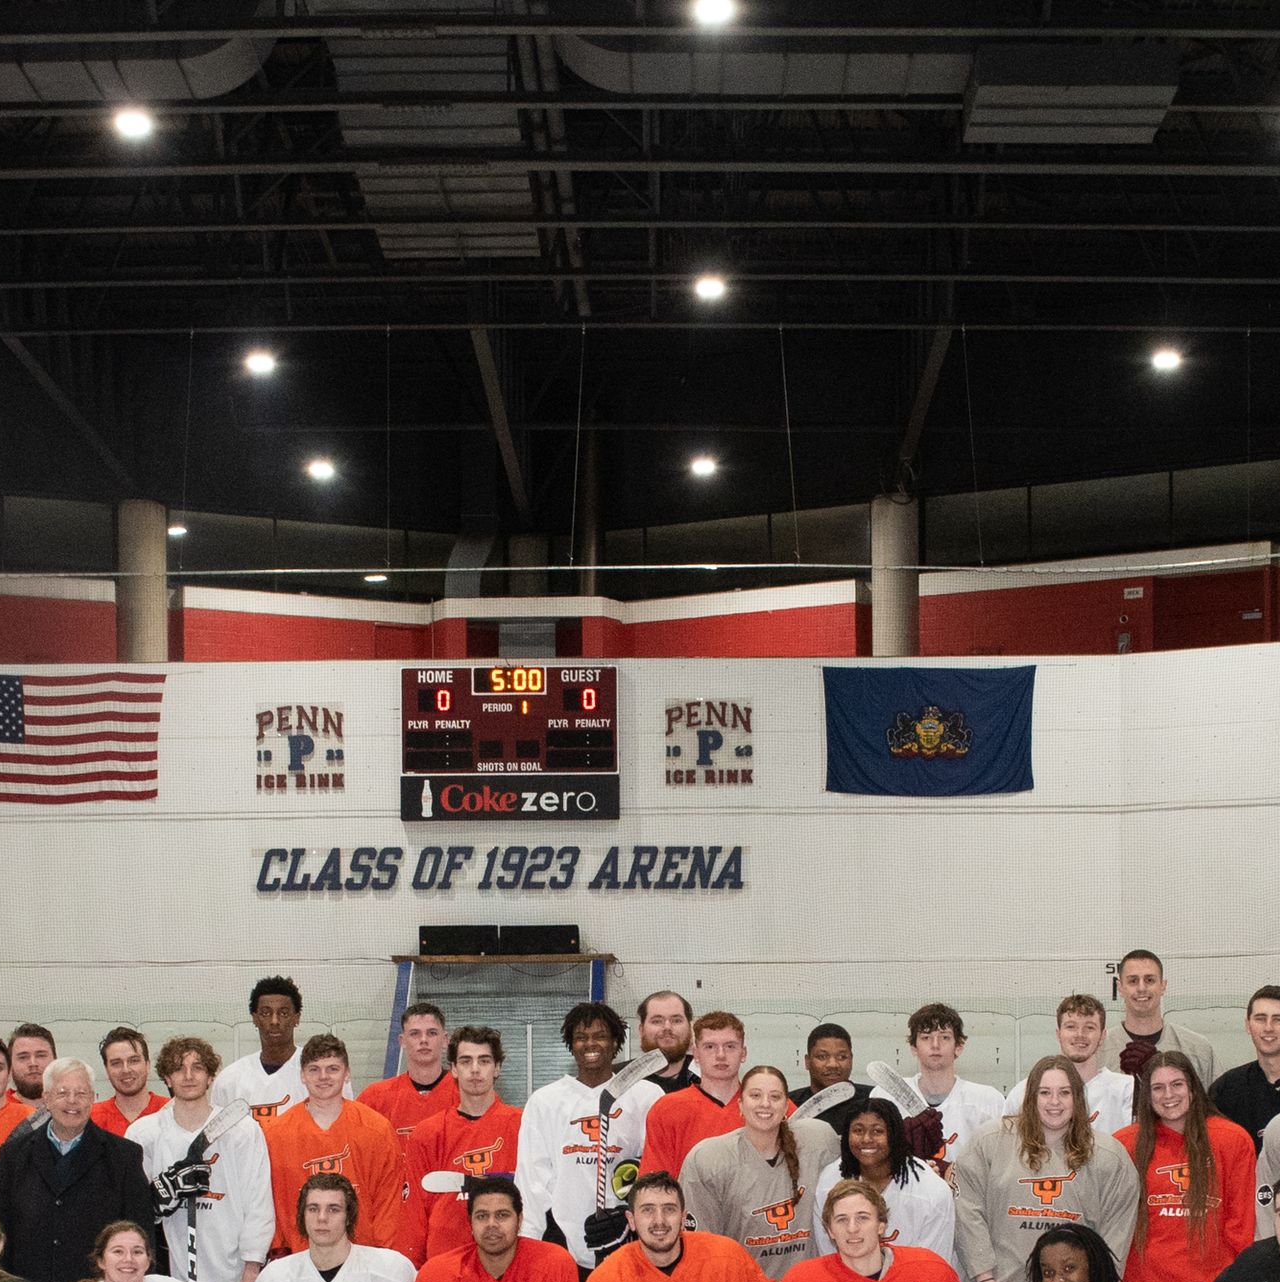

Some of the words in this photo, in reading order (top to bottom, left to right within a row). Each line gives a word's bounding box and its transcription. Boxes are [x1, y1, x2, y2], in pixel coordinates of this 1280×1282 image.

[418, 670, 453, 684] HOME
[491, 668, 542, 691] 5:00
[561, 669, 601, 683] GUEST
[437, 689, 451, 712] 0
[482, 703, 513, 713] PERIOD
[582, 688, 596, 711] 0
[256, 705, 344, 740] PENN
[408, 719, 429, 730] PLYR
[435, 719, 471, 730] PENALTY
[548, 718, 569, 729] PLYR
[575, 718, 611, 729] PENALTY
[665, 701, 752, 736] PENN
[288, 734, 315, 771] P
[696, 730, 724, 766] P
[477, 762, 504, 772] SHOTS
[506, 762, 519, 772] ON
[520, 761, 542, 772] GOAL
[256, 774, 287, 789] ICE
[295, 773, 345, 788] RINK
[665, 769, 697, 784] ICE
[704, 769, 753, 784] RINK
[439, 784, 518, 813] Coke
[521, 791, 596, 812] zero
[256, 846, 404, 892] CLASS
[412, 846, 474, 891] OF
[477, 846, 581, 890] 1923
[588, 846, 743, 889] ARENA
[759, 1244, 806, 1258] ALUMNI
